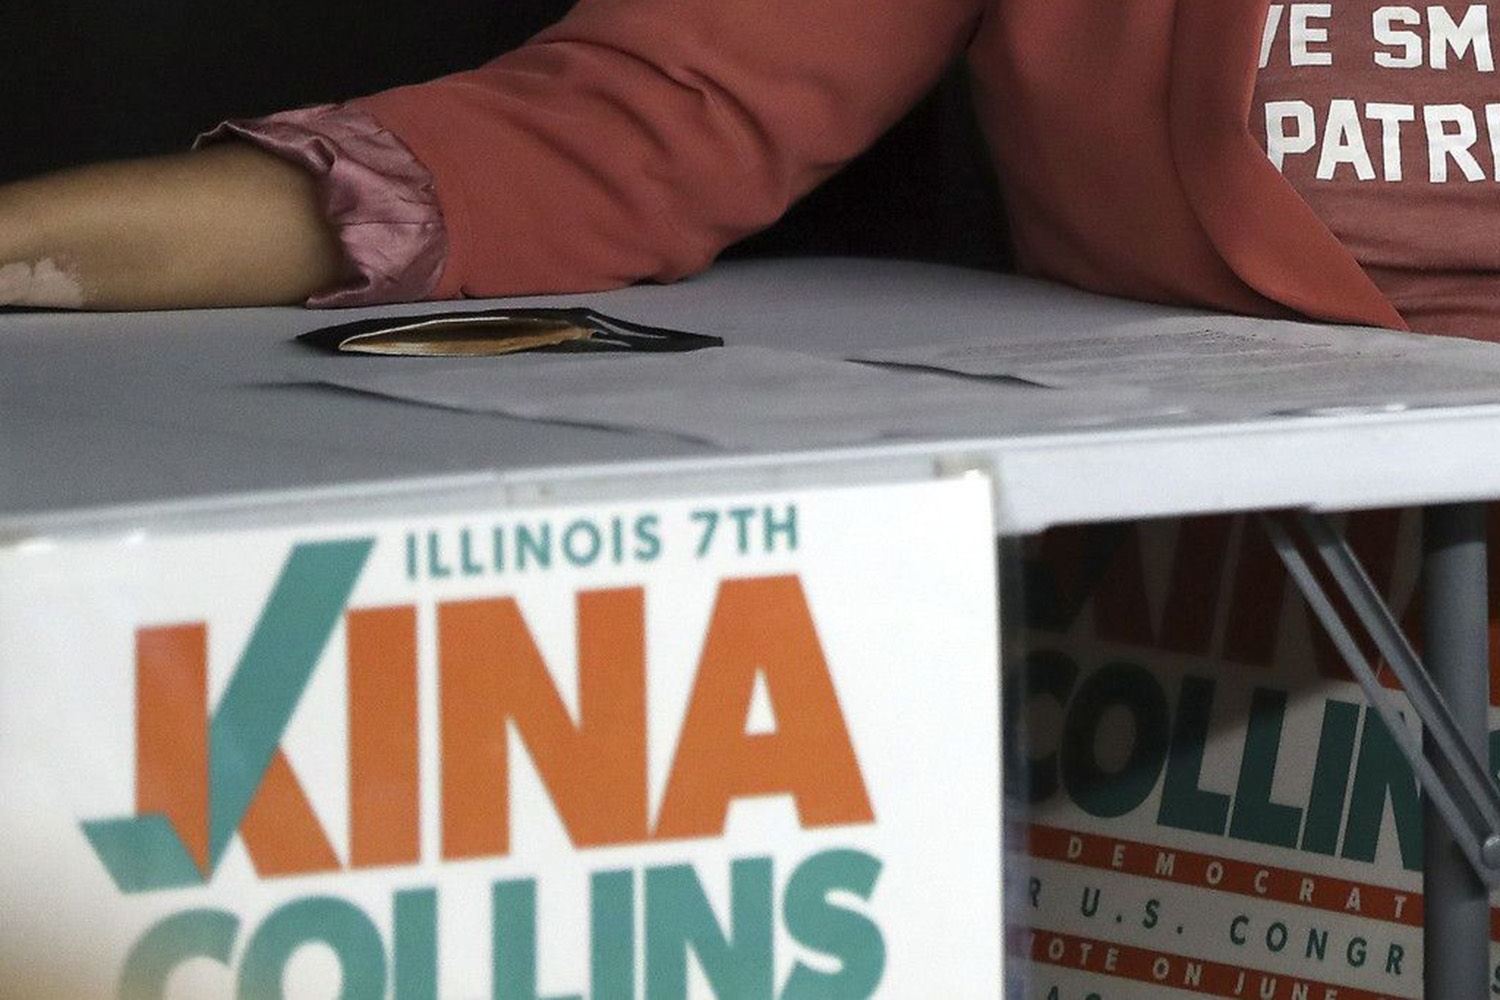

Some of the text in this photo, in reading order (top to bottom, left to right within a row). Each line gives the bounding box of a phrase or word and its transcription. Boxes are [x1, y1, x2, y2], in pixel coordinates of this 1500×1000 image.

[406, 505, 801, 579] ILLINOIS 7TH
[79, 537, 877, 894] KINA
[1067, 836, 1407, 918] DEMOCRAT
[1081, 887, 1184, 935] U.S.
[117, 847, 887, 1000] COLLINS
[1153, 957, 1202, 986] ON
